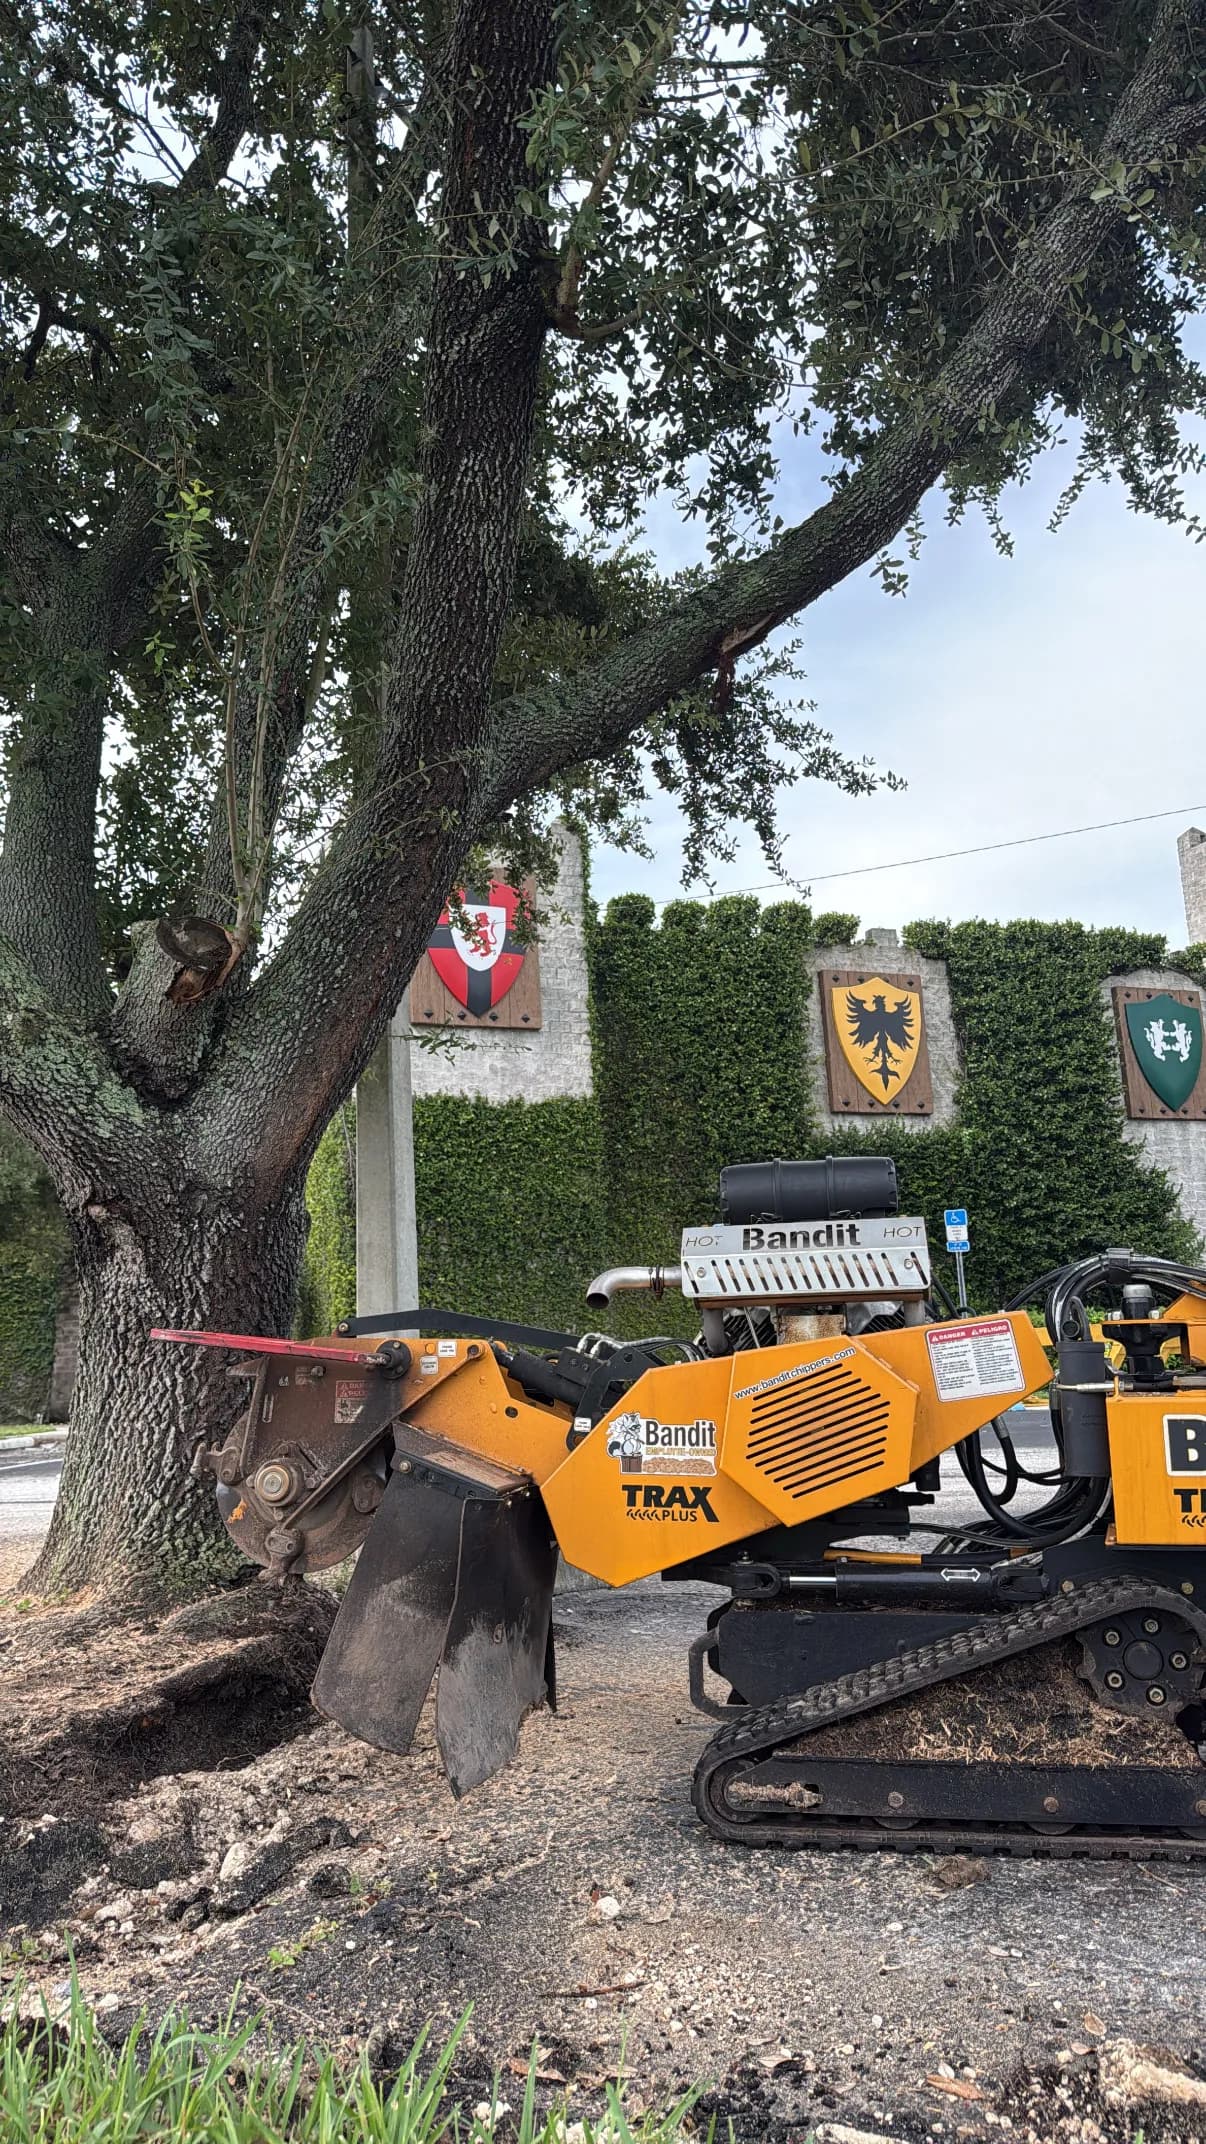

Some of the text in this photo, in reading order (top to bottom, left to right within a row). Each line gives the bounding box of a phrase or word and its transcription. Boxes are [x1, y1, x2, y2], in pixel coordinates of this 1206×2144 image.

[686, 1223, 921, 1251] HOT Bandit HOT
[938, 1325, 1007, 1341] DANGER PELIGRO
[734, 1347, 855, 1399] www.banditchippers.com
[645, 1420, 716, 1448] Bandit
[621, 1484, 720, 1522] TRAX
[662, 1510, 698, 1522] PLUS
